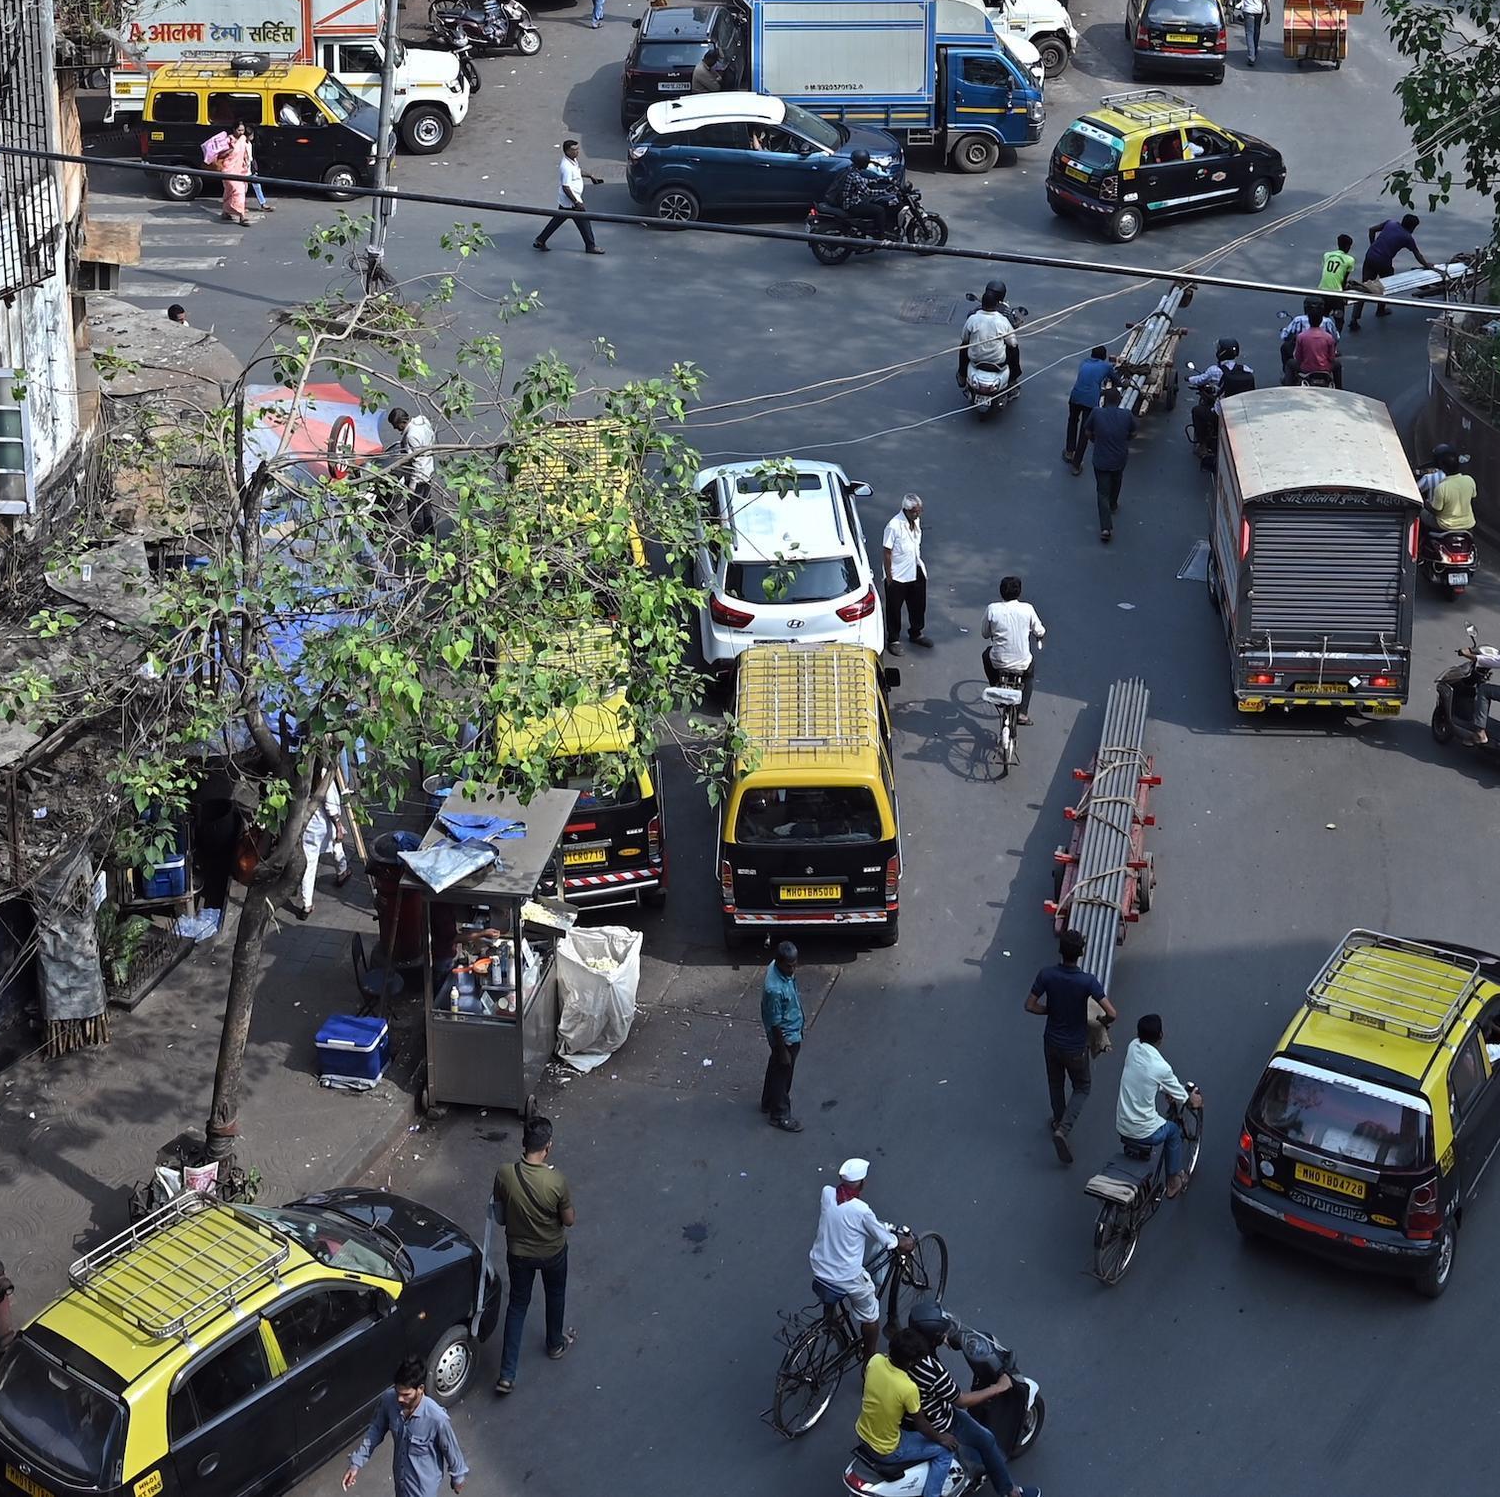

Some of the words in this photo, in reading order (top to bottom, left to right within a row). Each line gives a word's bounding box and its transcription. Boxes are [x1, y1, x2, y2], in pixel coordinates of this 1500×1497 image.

[148, 22, 205, 43] आलम
[209, 22, 244, 43] टेम्पो
[1327, 260, 1340, 273] 07
[785, 886, 839, 898] MH01BM5001
[1302, 1167, 1364, 1195] MH01BD4728
